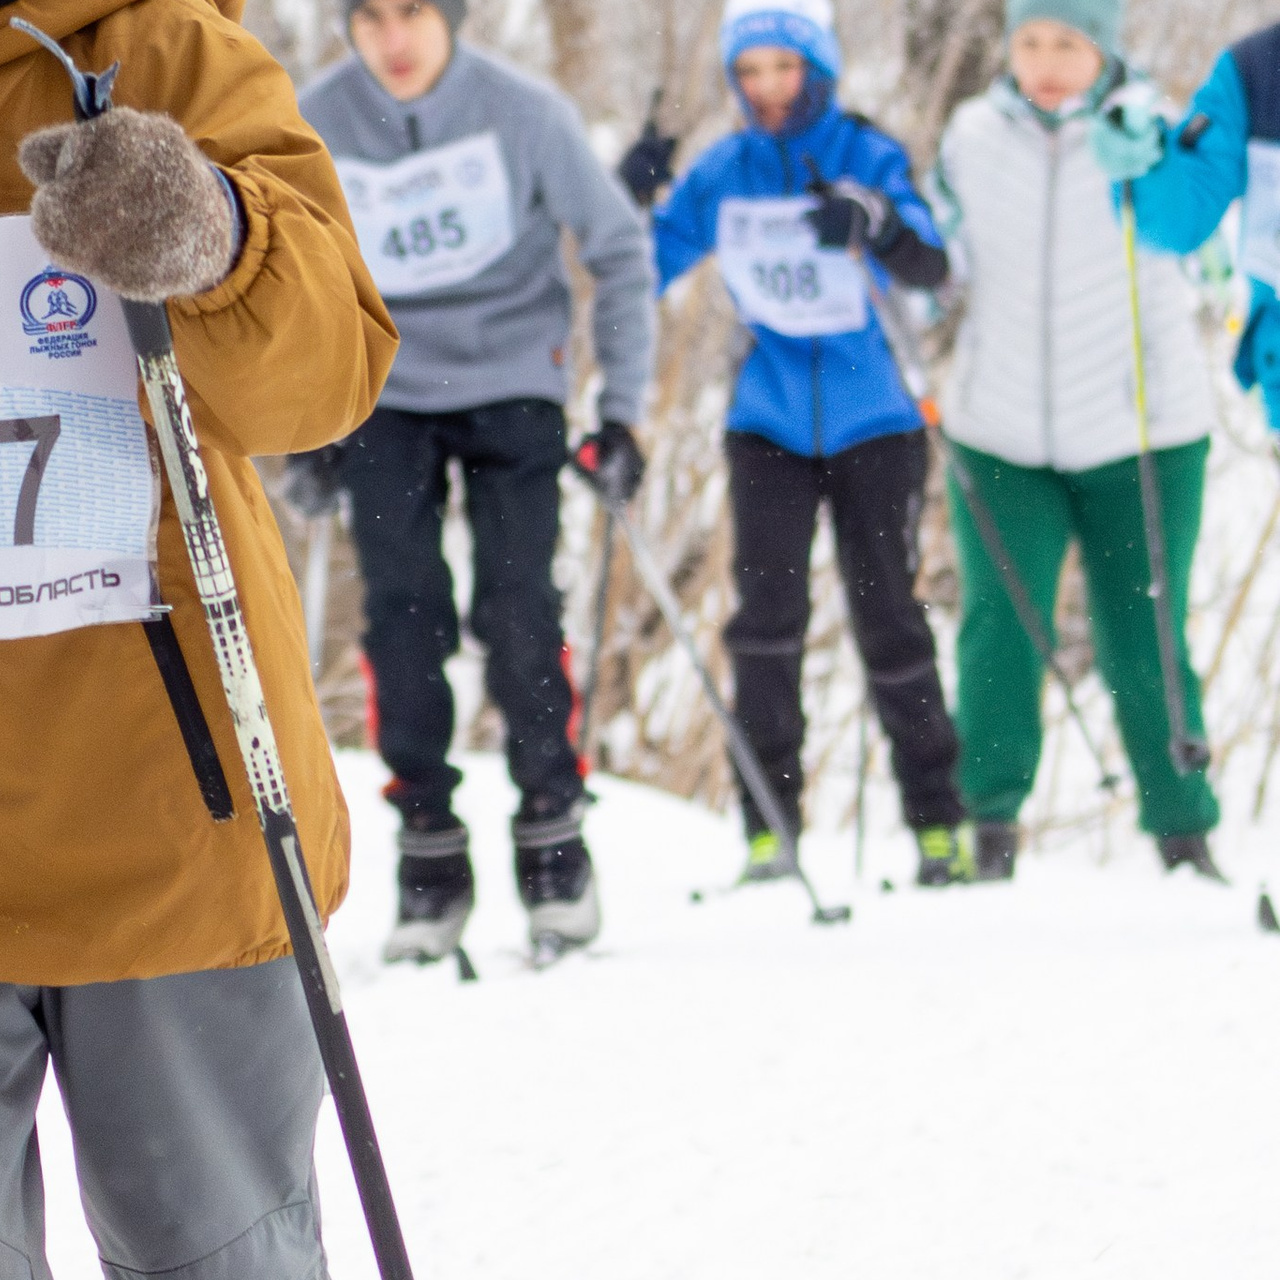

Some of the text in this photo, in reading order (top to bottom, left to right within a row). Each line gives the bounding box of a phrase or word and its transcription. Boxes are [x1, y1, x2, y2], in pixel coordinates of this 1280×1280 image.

[382, 206, 468, 262] 485
[38, 333, 88, 344] ФЕДЕРАЦИЯ
[49, 349, 82, 359] РОССИИ
